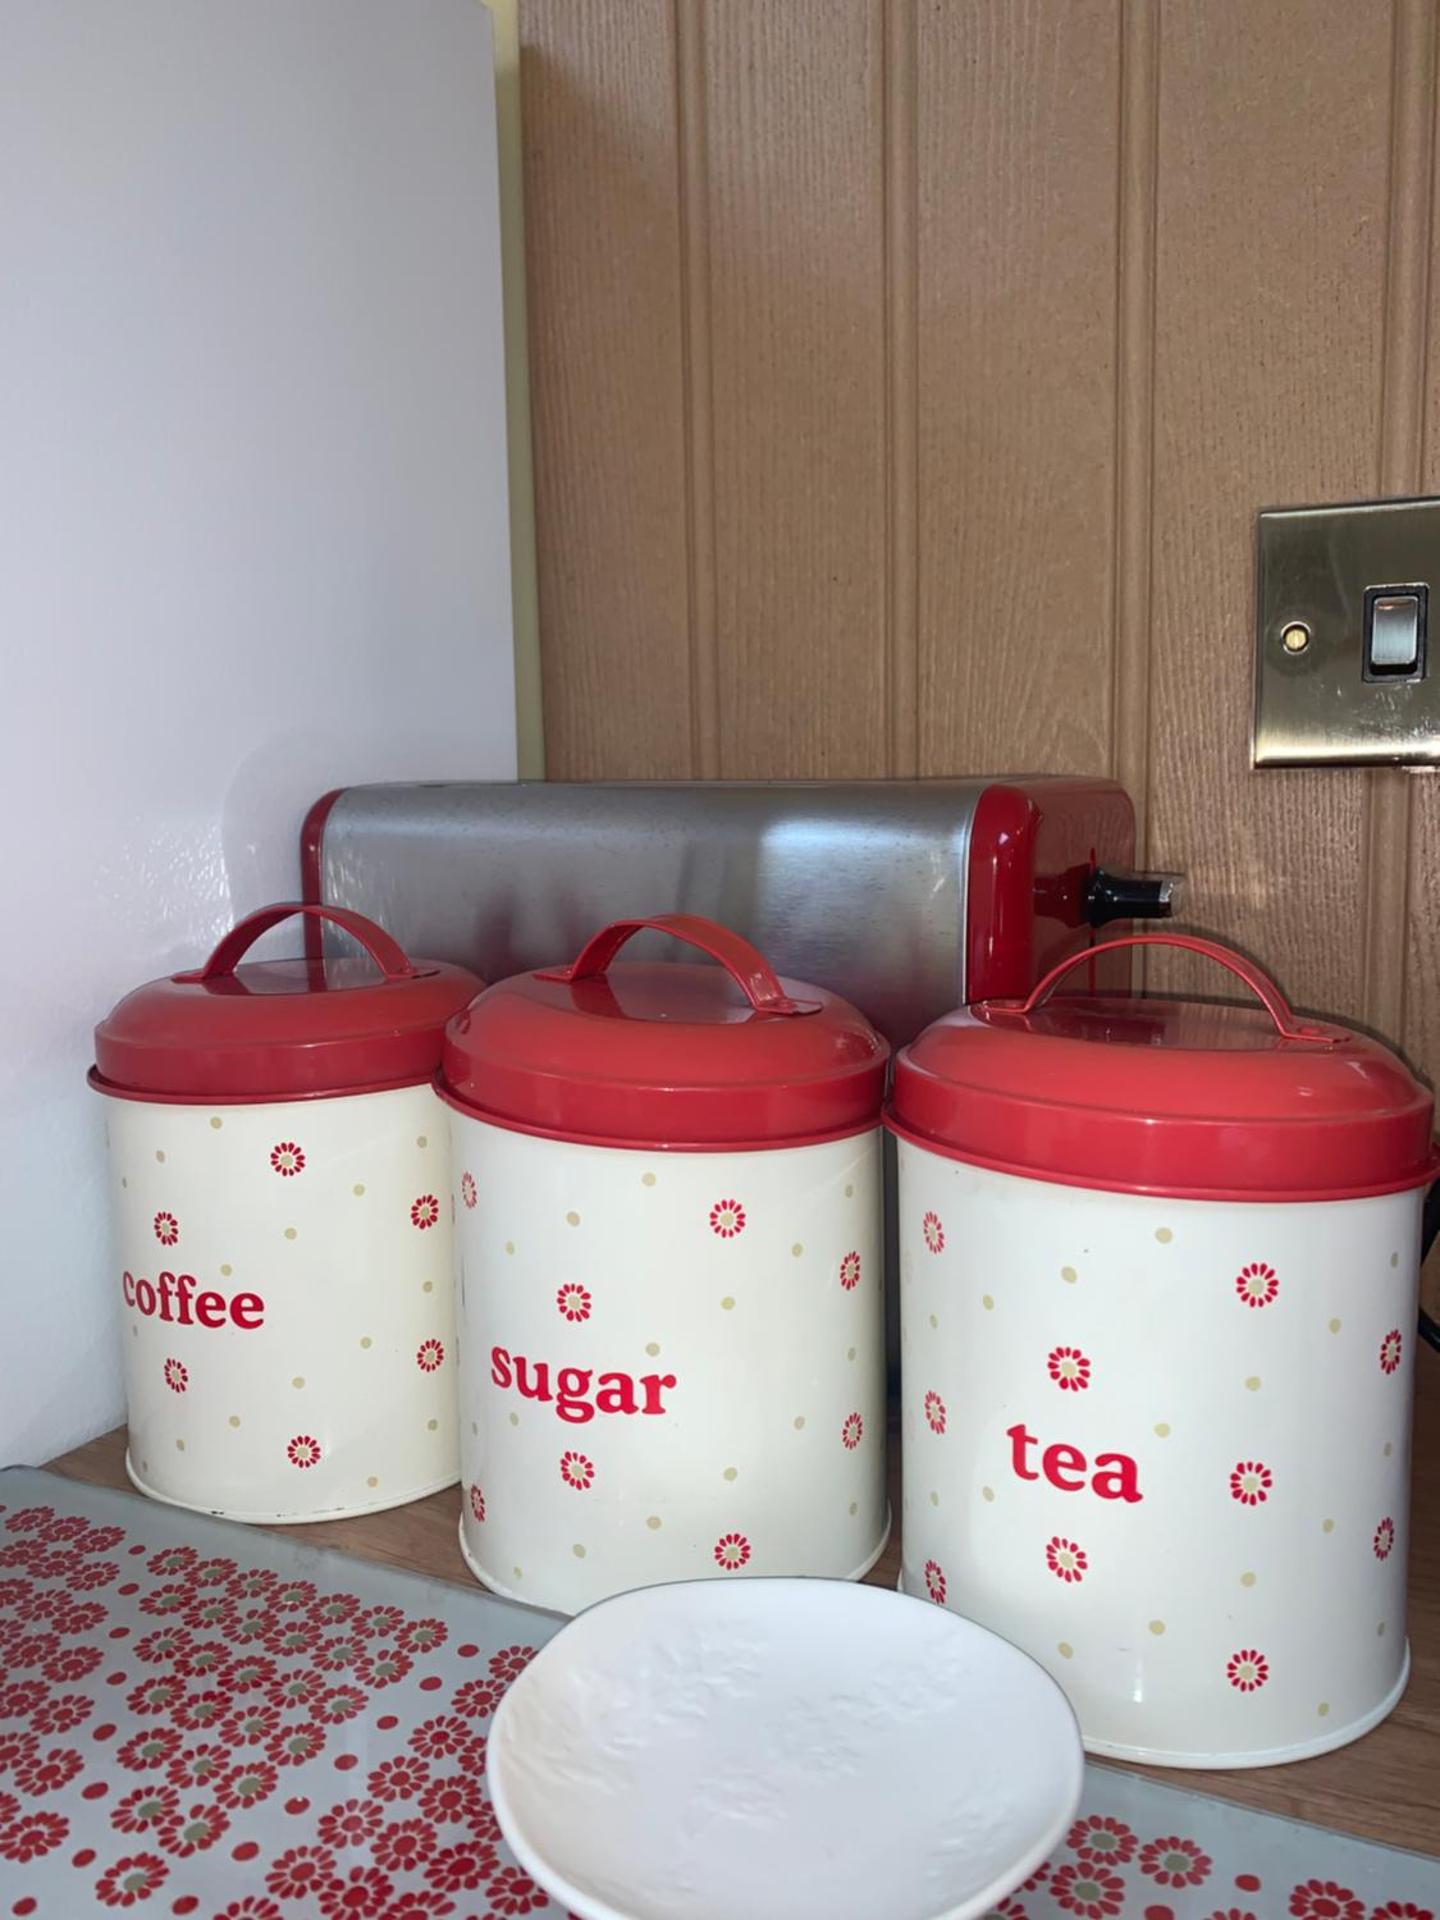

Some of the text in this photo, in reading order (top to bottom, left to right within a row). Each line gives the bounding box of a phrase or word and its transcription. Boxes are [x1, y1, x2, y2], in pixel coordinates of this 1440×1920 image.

[122, 1270, 265, 1330] coffee
[491, 1346, 677, 1424] sugar
[1007, 1424, 1143, 1504] tea
